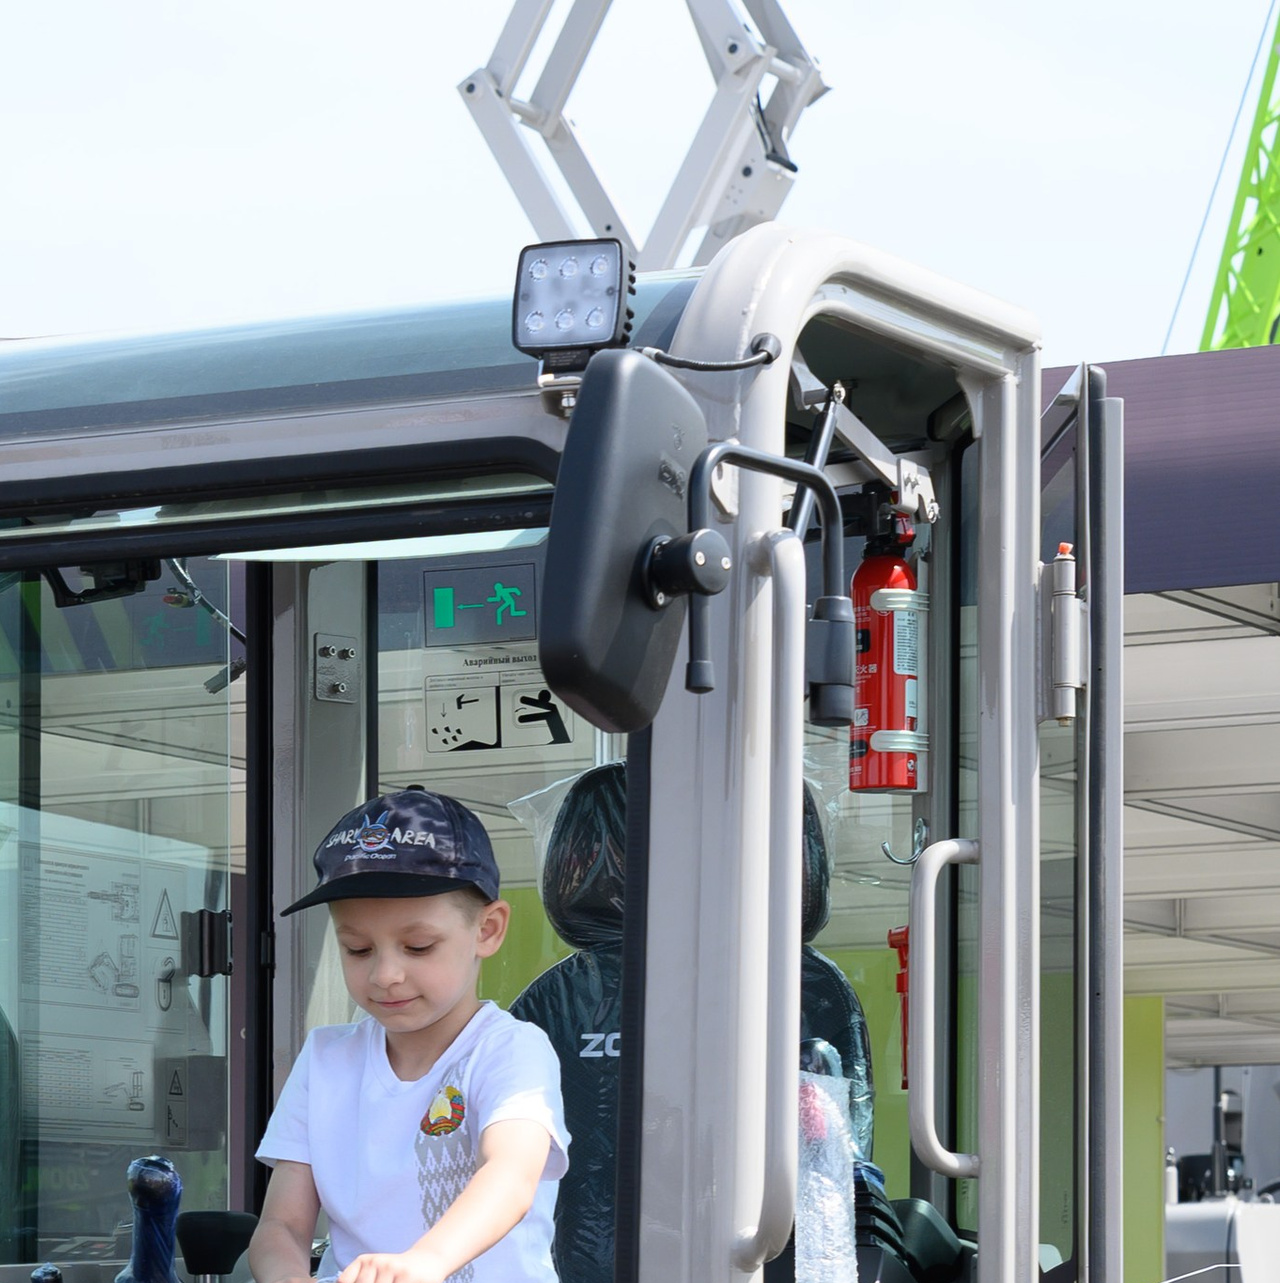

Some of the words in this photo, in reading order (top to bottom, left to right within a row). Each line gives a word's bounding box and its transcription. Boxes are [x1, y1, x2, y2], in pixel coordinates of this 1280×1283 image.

[462, 655, 510, 668] Аварийный
[511, 654, 537, 664] выход
[389, 827, 436, 849] AREA
